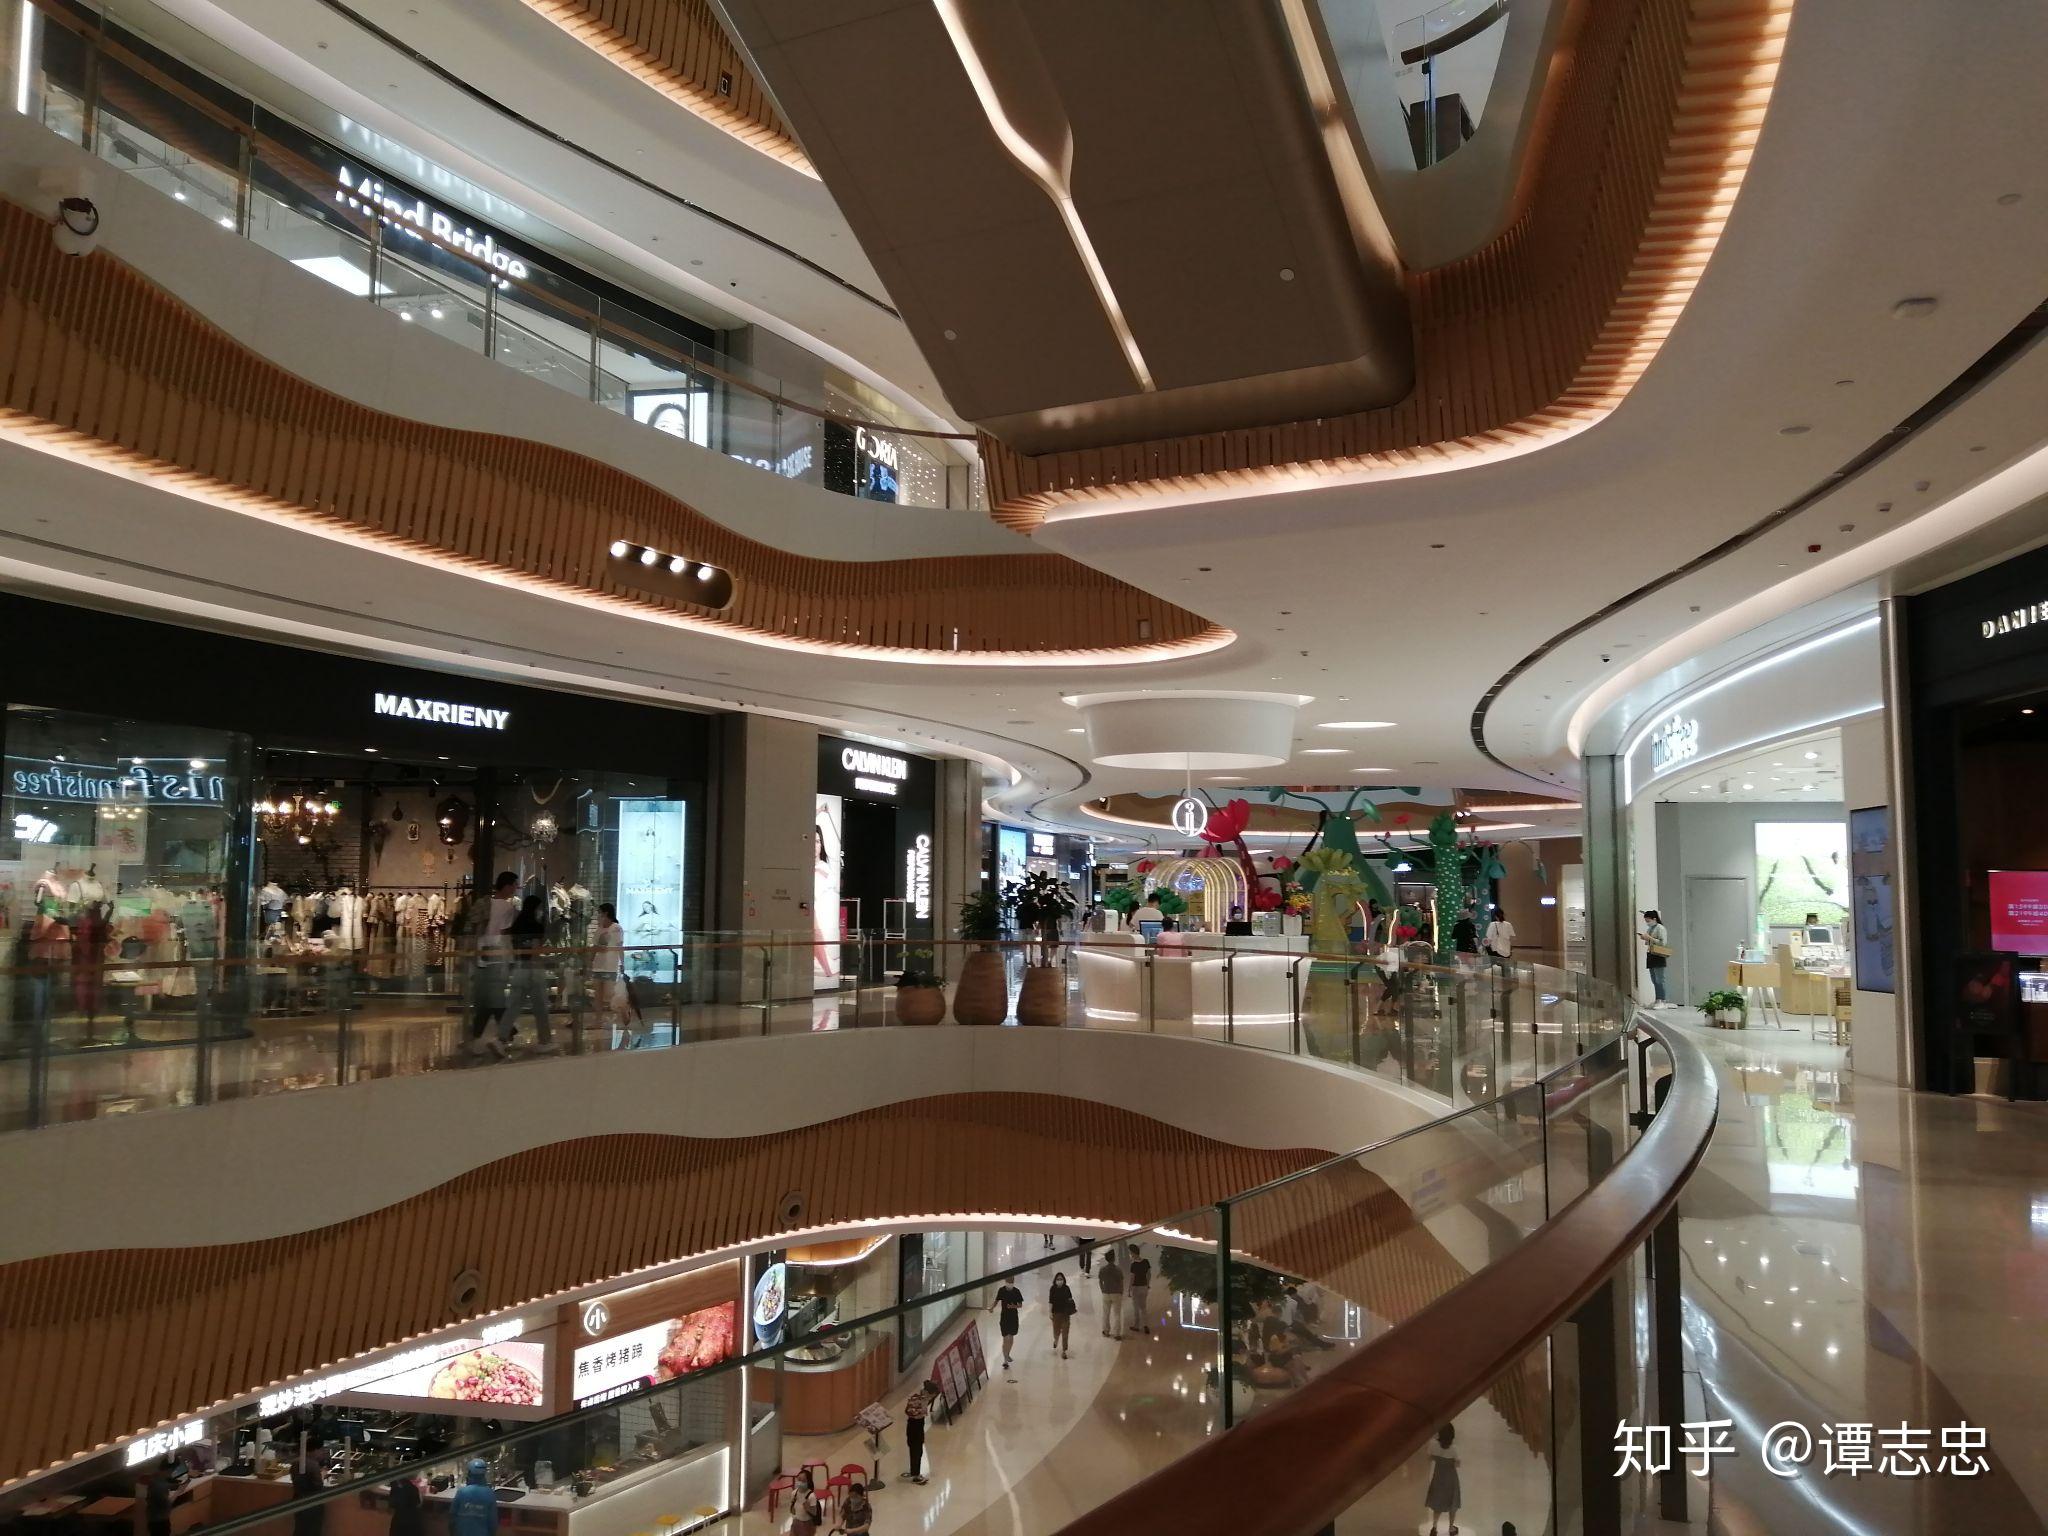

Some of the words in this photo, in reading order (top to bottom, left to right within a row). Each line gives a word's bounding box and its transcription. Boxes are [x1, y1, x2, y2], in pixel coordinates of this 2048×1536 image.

[335, 165, 426, 240] Mind
[431, 211, 529, 289] Bridge
[374, 692, 510, 730] MAXRIENY
[915, 834, 930, 881] CALVIN
[915, 882, 930, 919] KLEIN
[578, 1342, 643, 1379] 焦香烤猪蹄
